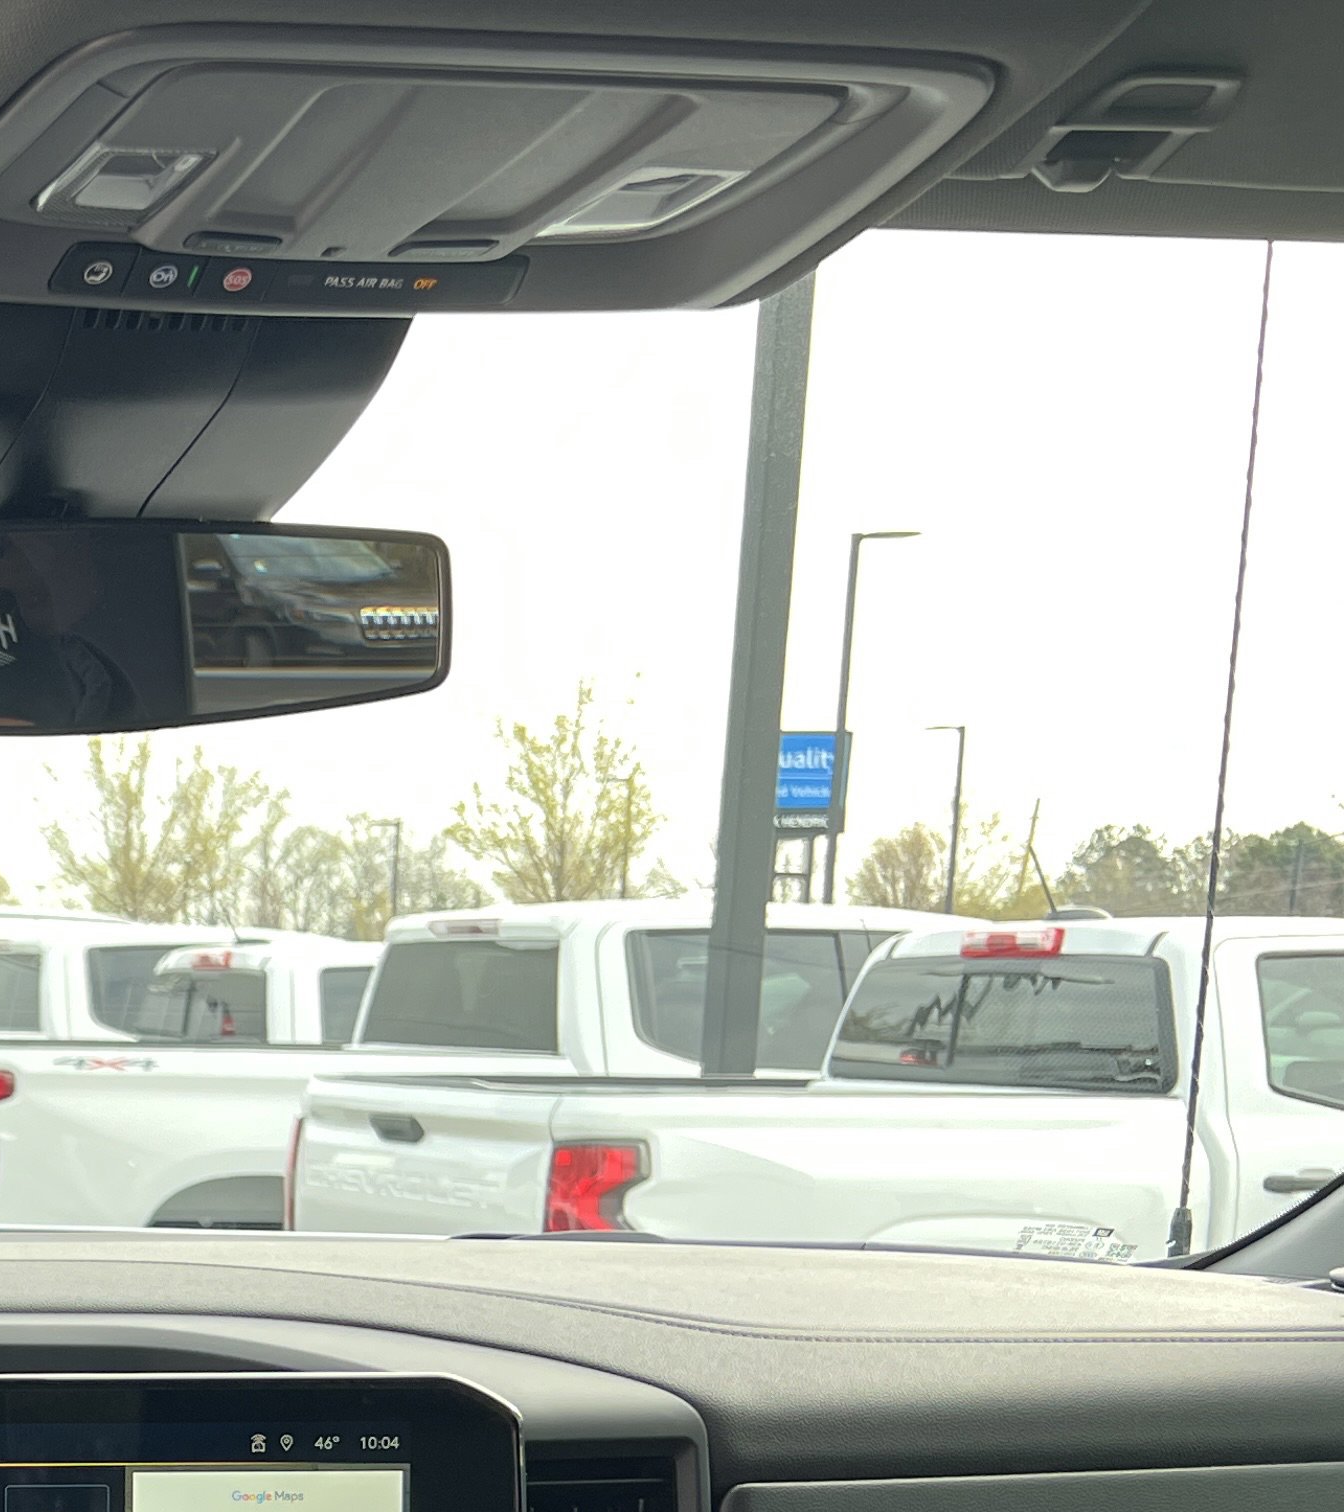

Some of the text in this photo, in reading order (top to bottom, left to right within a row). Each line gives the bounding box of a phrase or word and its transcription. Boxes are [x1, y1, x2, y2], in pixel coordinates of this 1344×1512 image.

[227, 274, 248, 287] SOS
[324, 276, 438, 290] PASS AIR BAG OFF
[778, 747, 834, 775] ualit
[360, 1436, 400, 1450] 10:04
[232, 1490, 304, 1504] Google Maps
